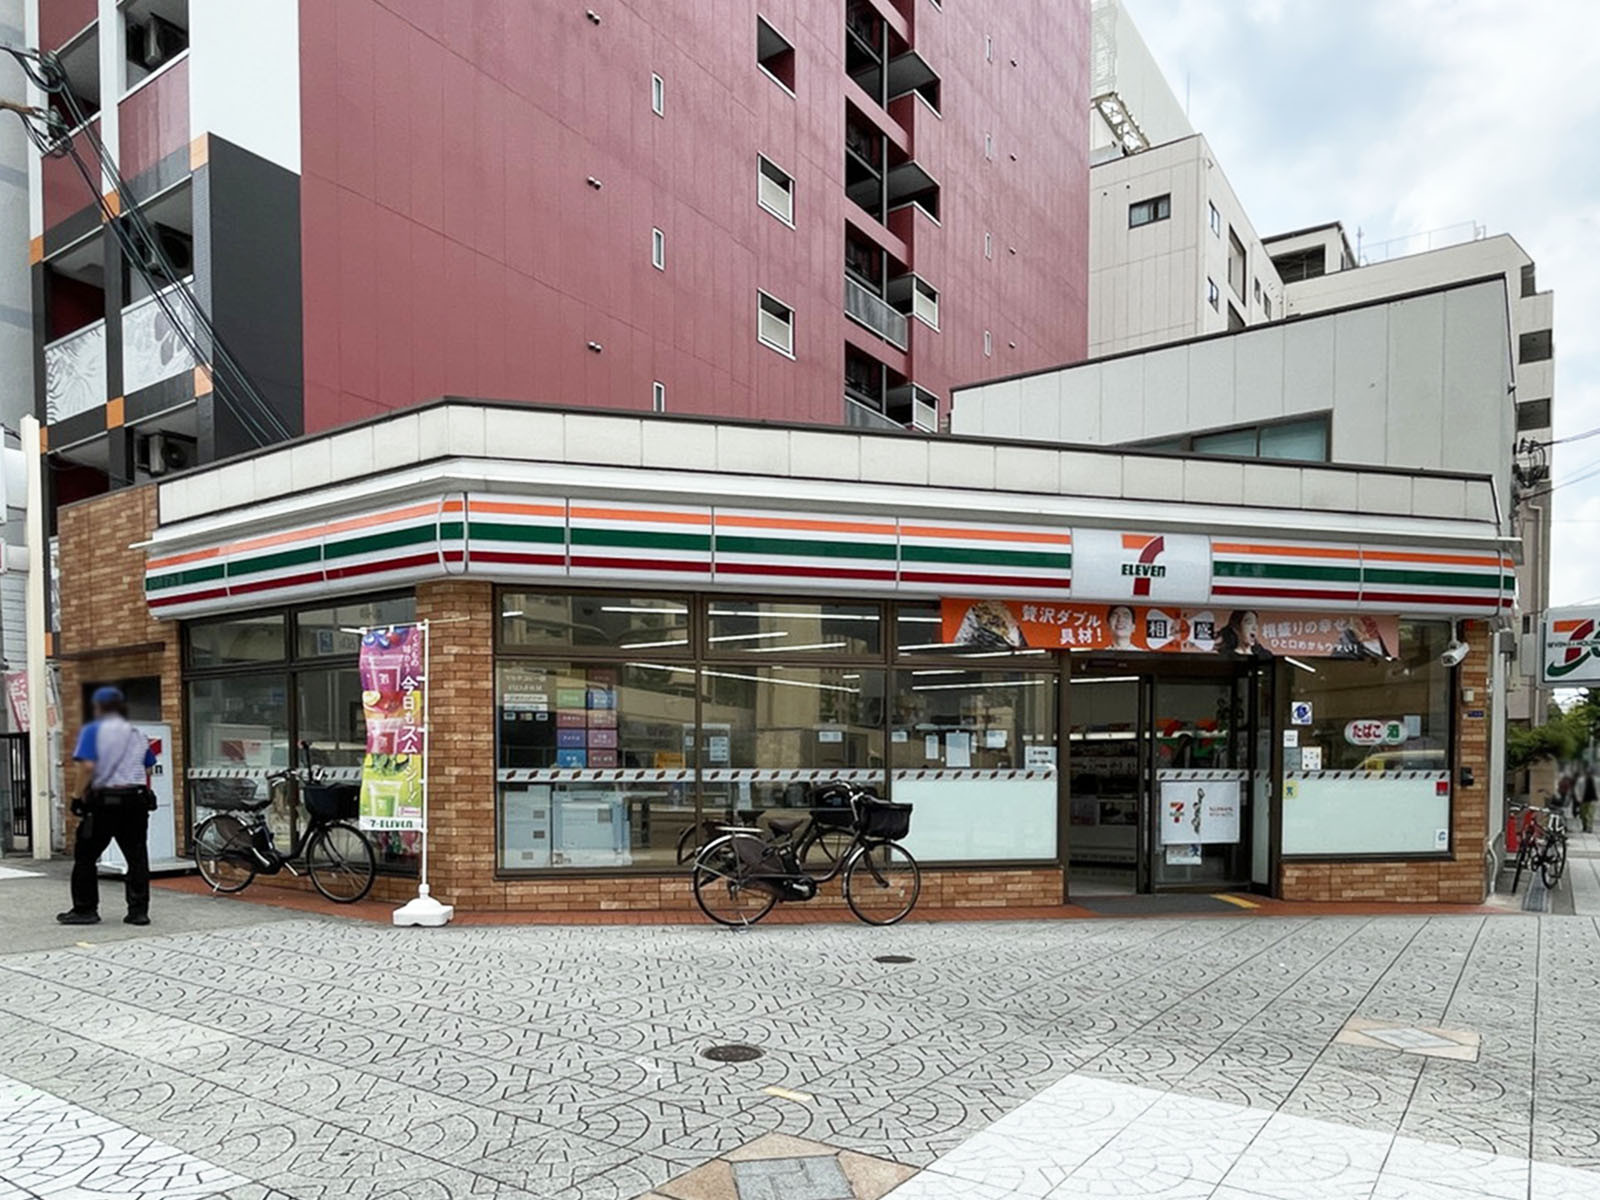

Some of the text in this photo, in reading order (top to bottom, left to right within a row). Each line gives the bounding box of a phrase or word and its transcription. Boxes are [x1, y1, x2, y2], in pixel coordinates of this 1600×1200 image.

[1022, 604, 1101, 627] 贅沢ダブル
[1147, 620, 1166, 637] 相
[1352, 724, 1382, 738] たばこ
